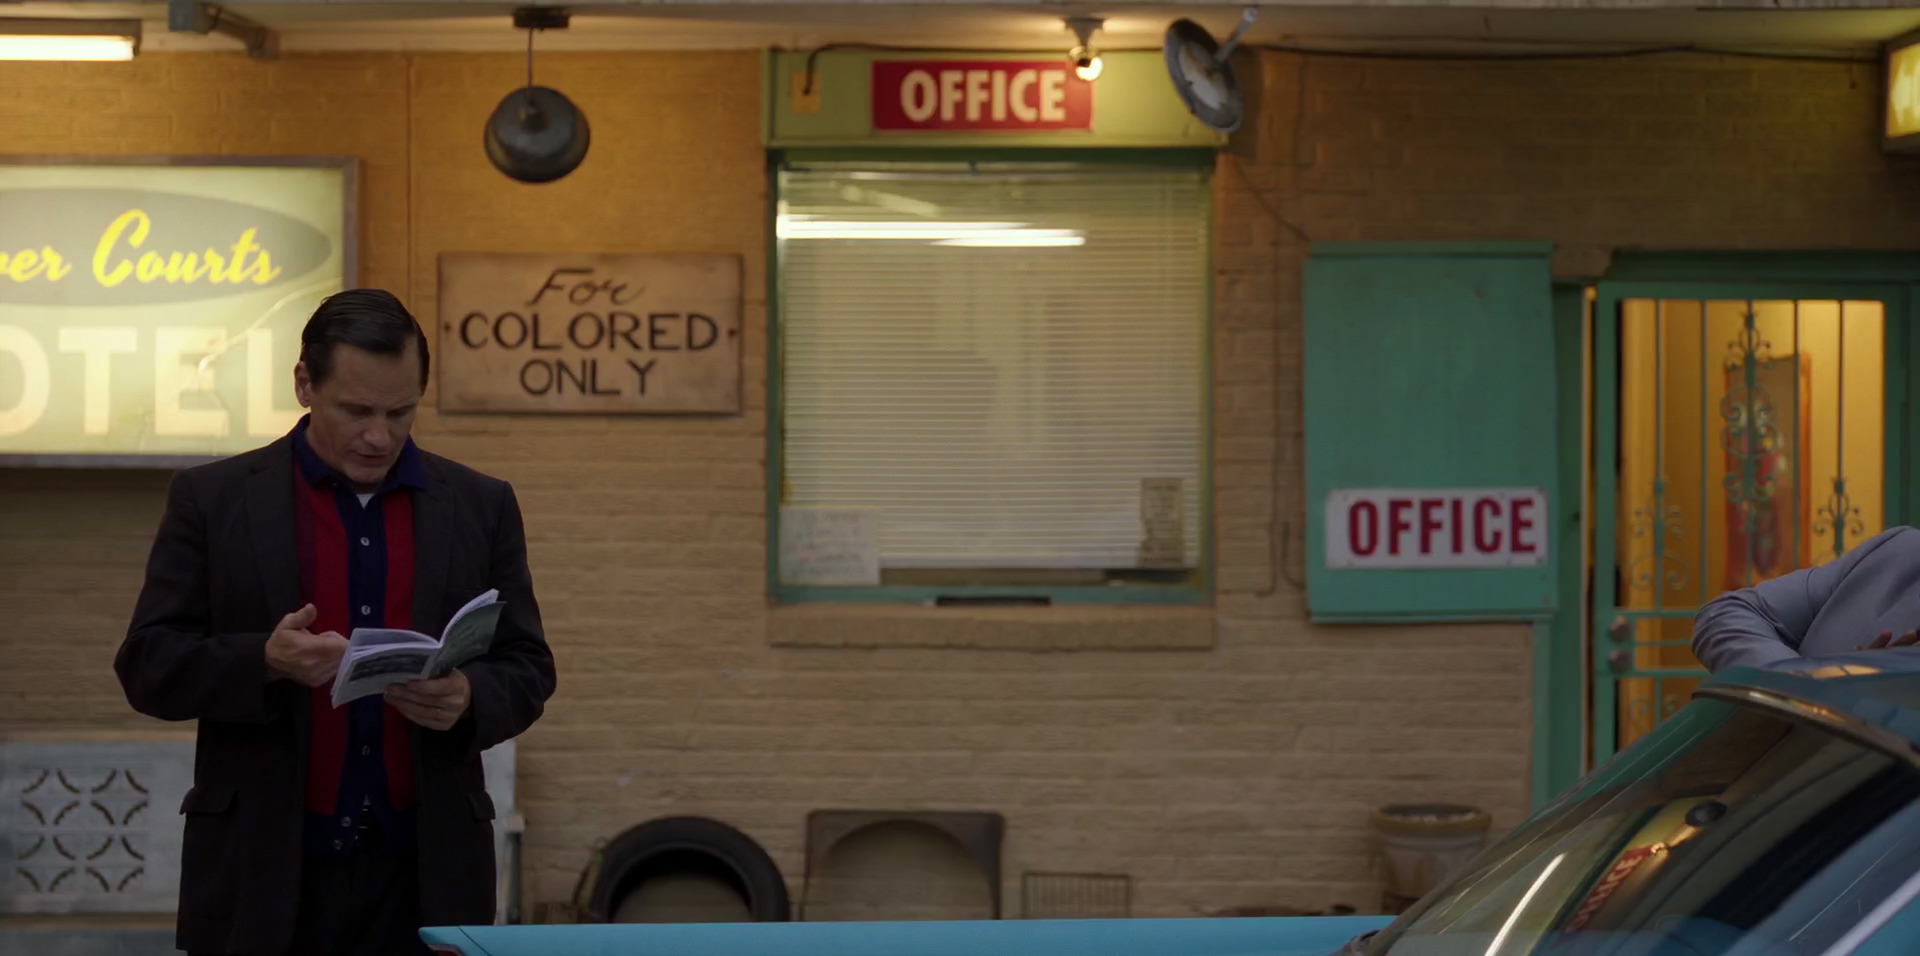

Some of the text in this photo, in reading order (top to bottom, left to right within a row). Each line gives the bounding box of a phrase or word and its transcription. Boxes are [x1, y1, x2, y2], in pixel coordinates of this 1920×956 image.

[901, 70, 1066, 121] OFFICE
[93, 210, 282, 287] Courts
[525, 269, 643, 305] For
[460, 312, 719, 350] COLORED
[521, 359, 656, 395] ONLY
[1349, 499, 1536, 555] OFFICE
